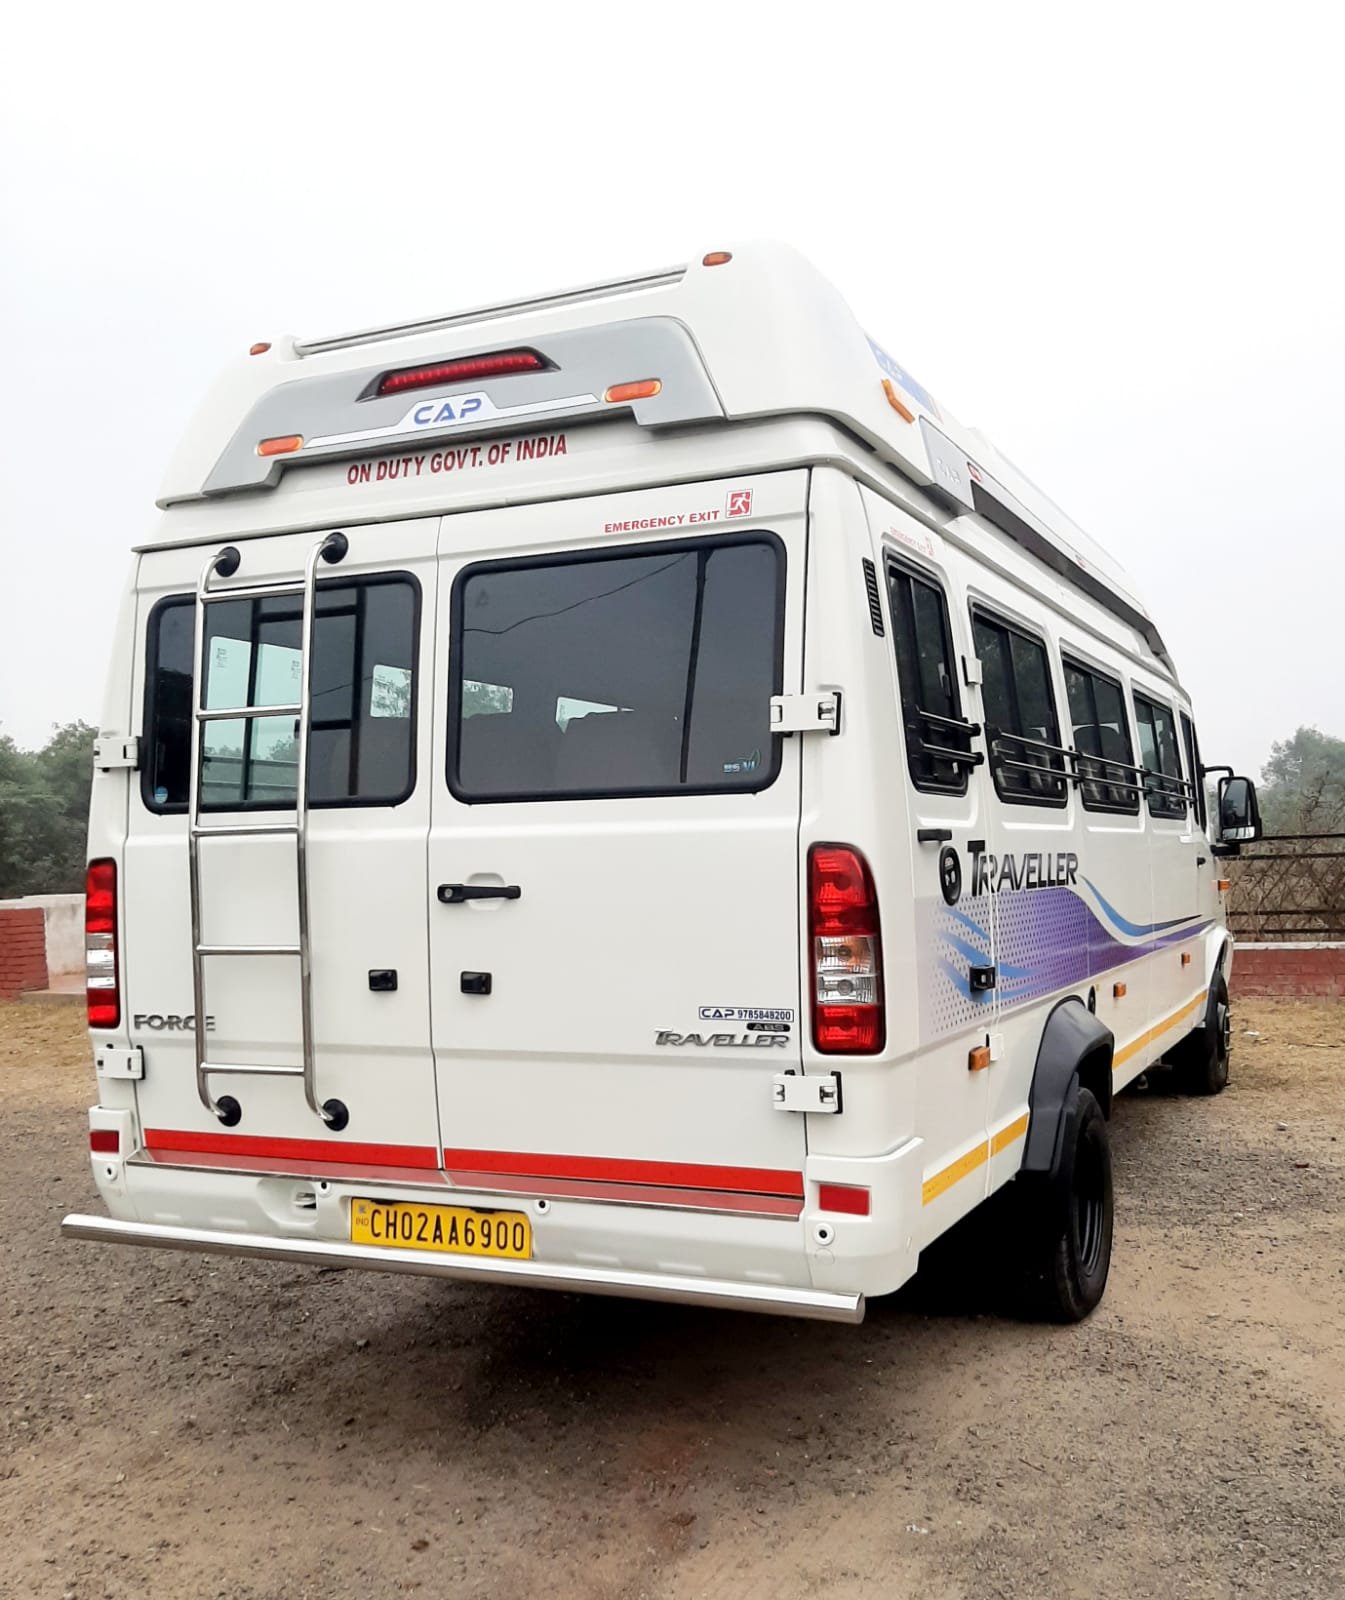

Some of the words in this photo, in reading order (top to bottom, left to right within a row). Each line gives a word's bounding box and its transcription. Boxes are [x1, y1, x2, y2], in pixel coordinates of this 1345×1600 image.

[413, 398, 481, 425] CAP
[346, 464, 372, 485] ON
[376, 454, 425, 481] DUTY
[430, 446, 483, 475] GOVT.
[487, 442, 512, 466] OF
[516, 434, 567, 461] INDIA
[604, 515, 685, 533] EMERGENCY
[689, 510, 720, 524] EXIT
[967, 839, 1079, 897] TRAVELLER
[133, 1013, 216, 1032] FORCE
[701, 1008, 735, 1019] CAP
[752, 1023, 785, 1031] ABS
[655, 1030, 789, 1048] TRAVELLER
[370, 1209, 525, 1251] CH02AA6900
